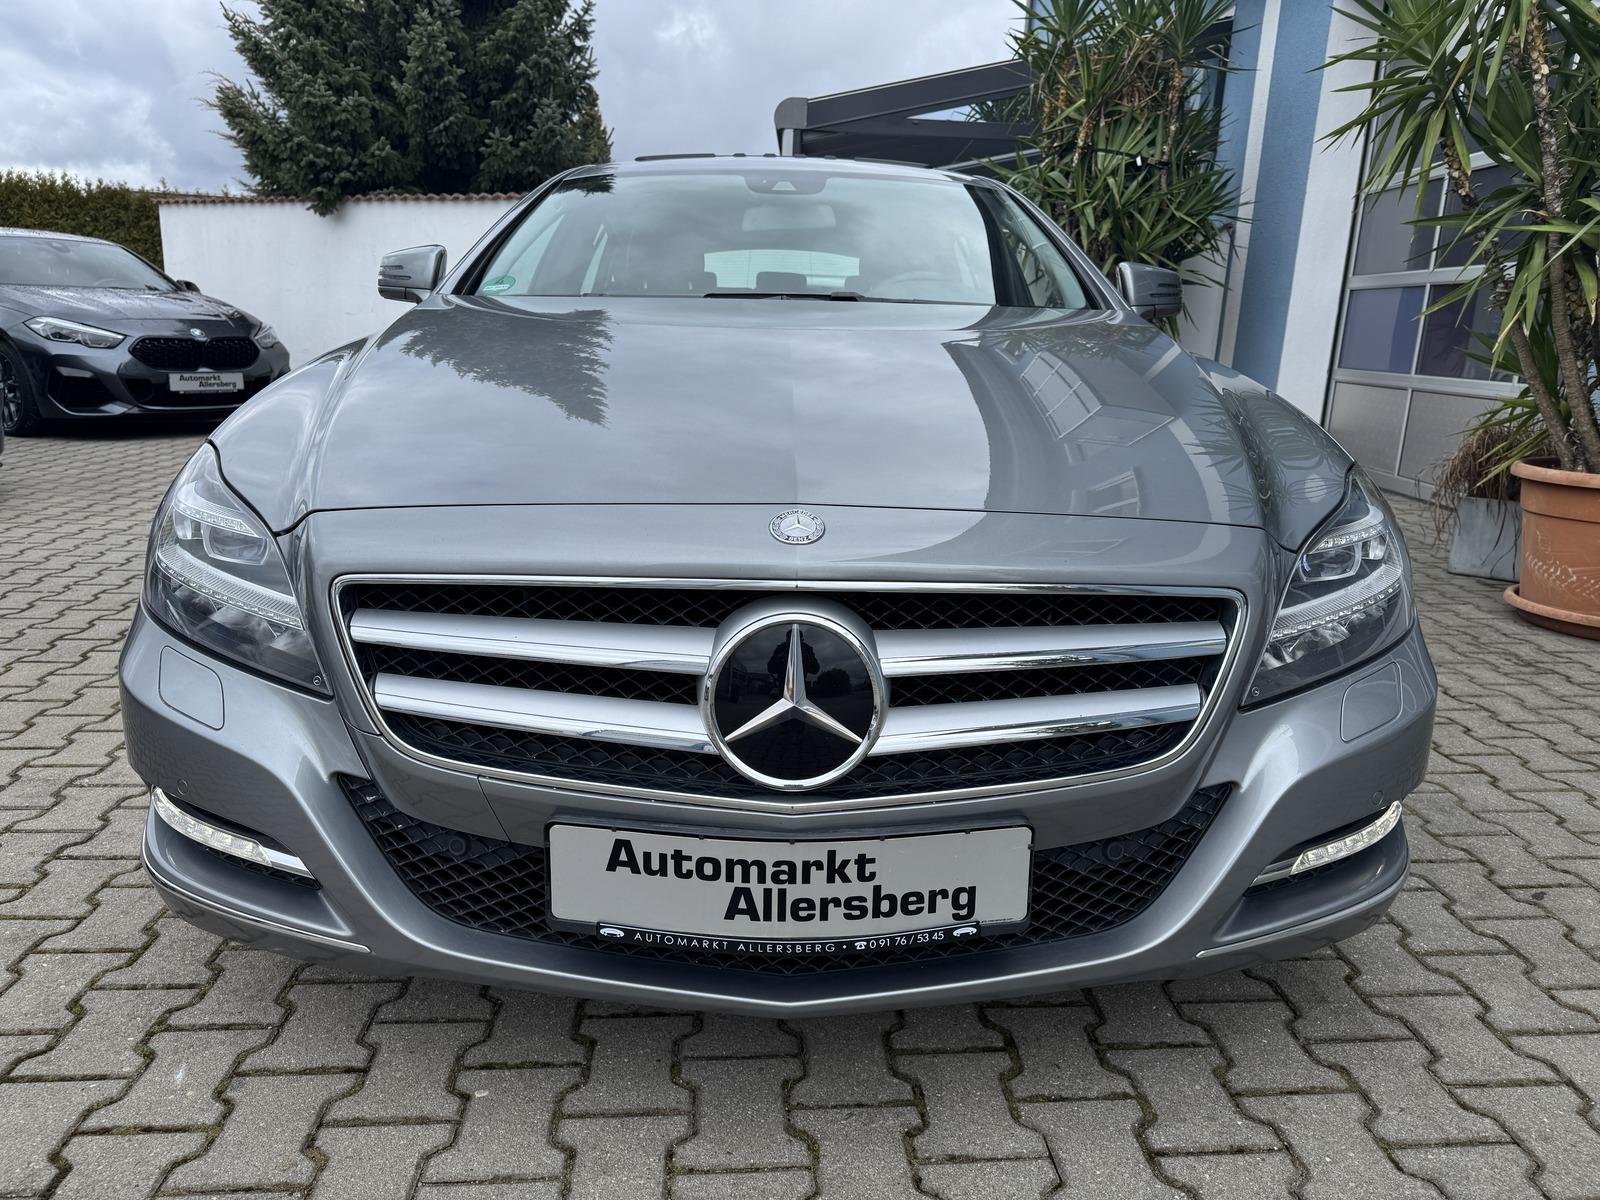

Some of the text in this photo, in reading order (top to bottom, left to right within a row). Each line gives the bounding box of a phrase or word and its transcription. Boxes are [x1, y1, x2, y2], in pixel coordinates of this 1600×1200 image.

[179, 374, 221, 382] Automarkt
[606, 838, 876, 884] Automarkt
[724, 885, 976, 921] Allersberg
[634, 932, 728, 950] AUTOMARKT
[737, 943, 835, 953] ALLERSBERG
